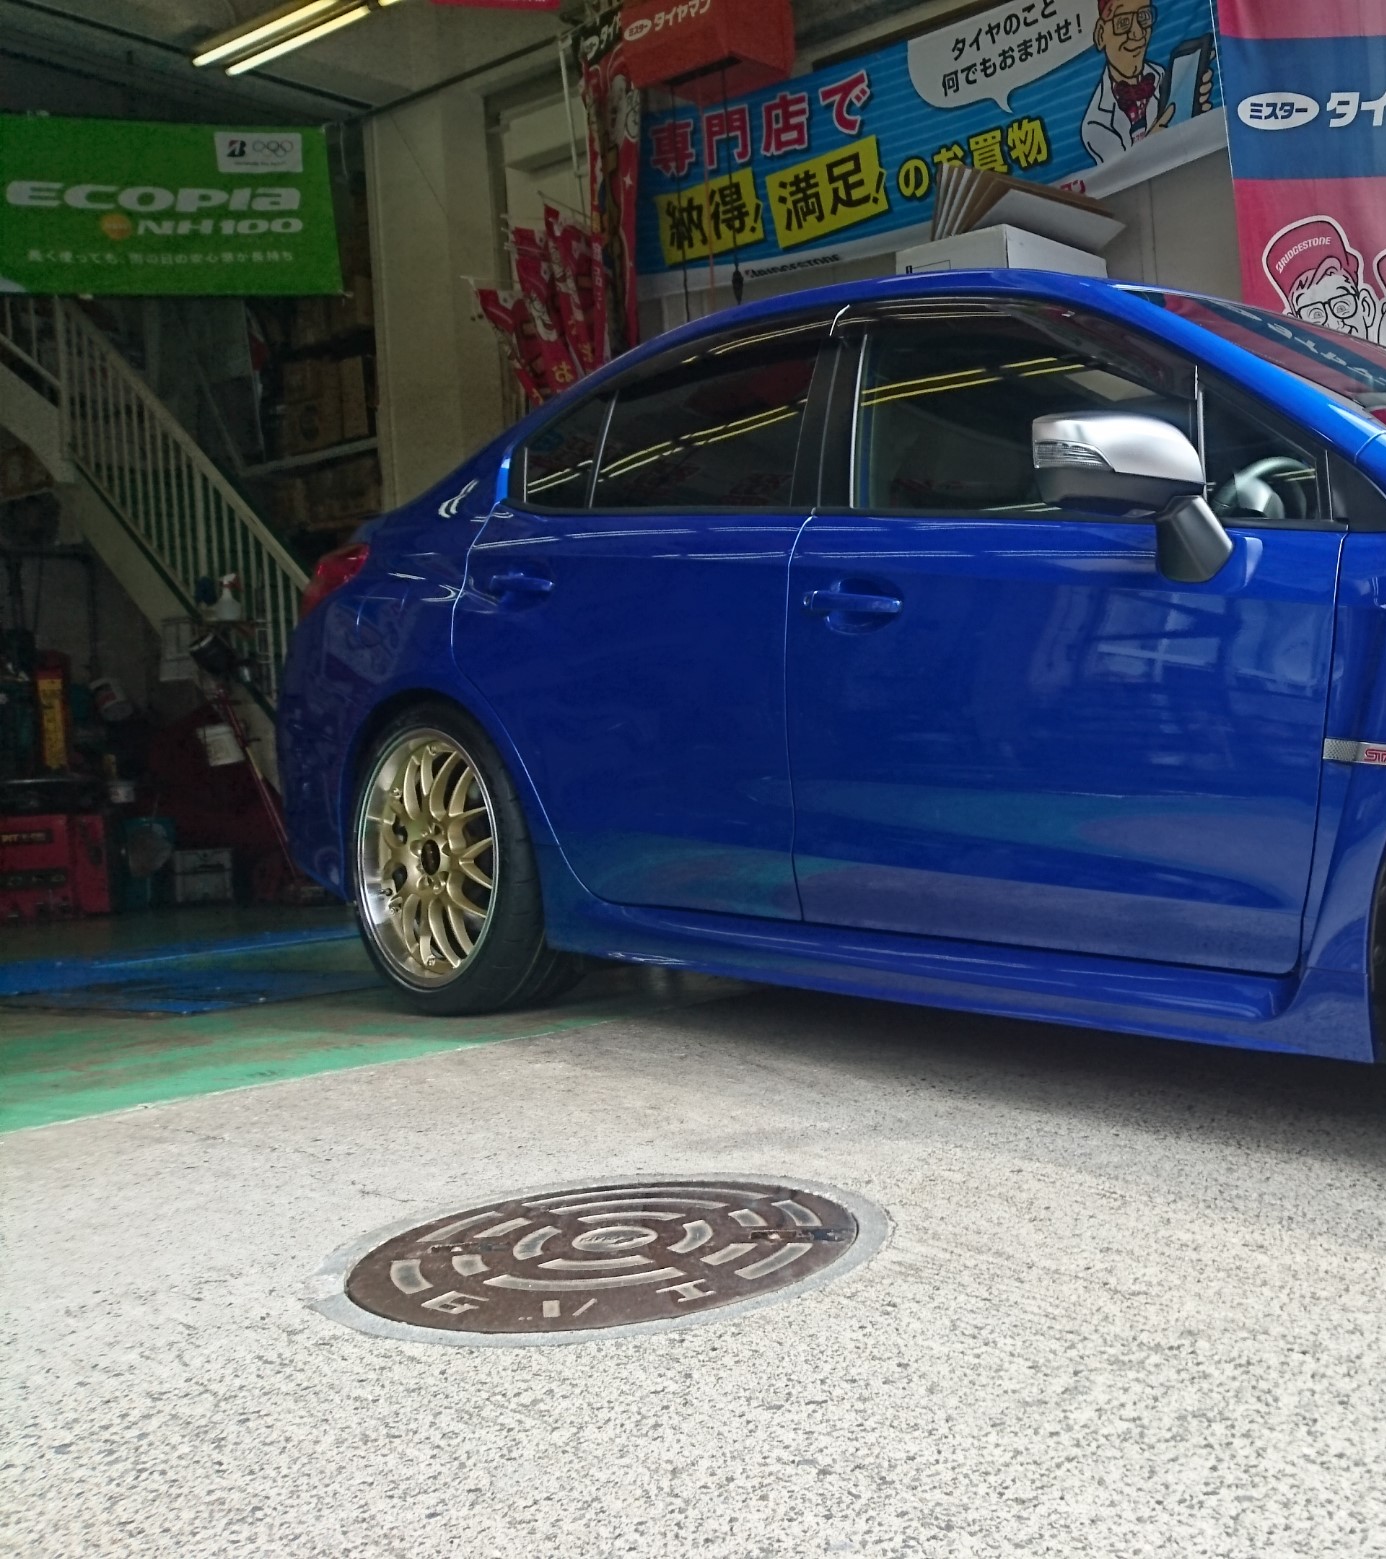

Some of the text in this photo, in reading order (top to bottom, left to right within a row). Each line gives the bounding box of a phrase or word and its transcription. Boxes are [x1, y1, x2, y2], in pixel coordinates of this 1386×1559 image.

[654, 0, 711, 31] タイヤマン
[951, 0, 1058, 61] タイヤのこと
[651, 70, 872, 178] 専門店で
[1249, 101, 1308, 120] ミスター
[6, 180, 301, 213] ECOPIA
[137, 218, 304, 236] NH100
[1275, 236, 1333, 274] BRIDGESTONE
